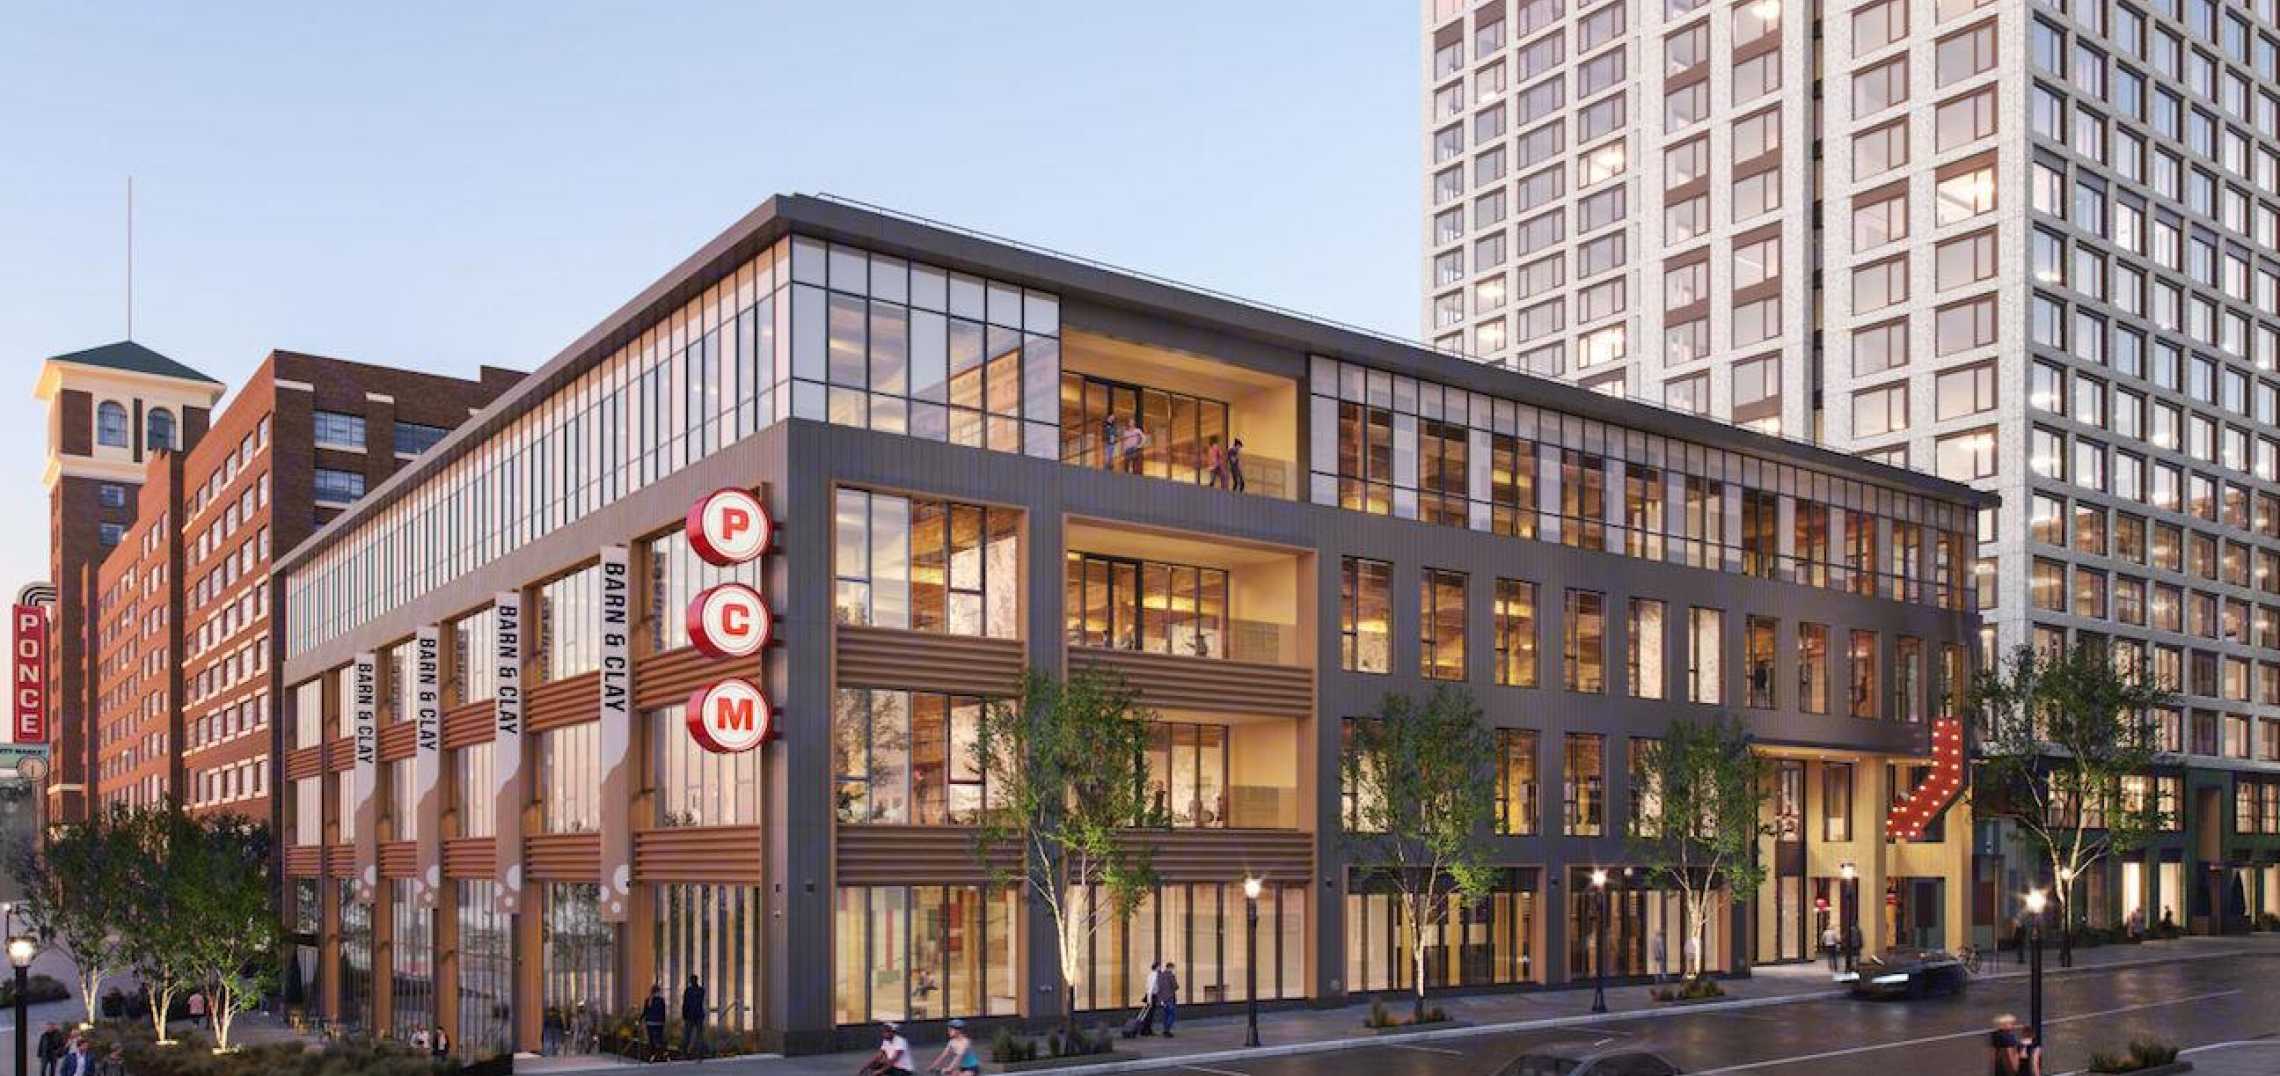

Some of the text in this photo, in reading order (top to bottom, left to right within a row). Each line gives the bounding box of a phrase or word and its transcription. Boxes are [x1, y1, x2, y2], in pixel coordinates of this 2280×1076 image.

[19, 614, 39, 734] PONCE
[419, 638, 437, 751] BARN & CLAY
[498, 605, 517, 734] BARN & CLAY
[604, 561, 625, 713] BARN & CLAY
[358, 663, 373, 764] BARN & CLAY
